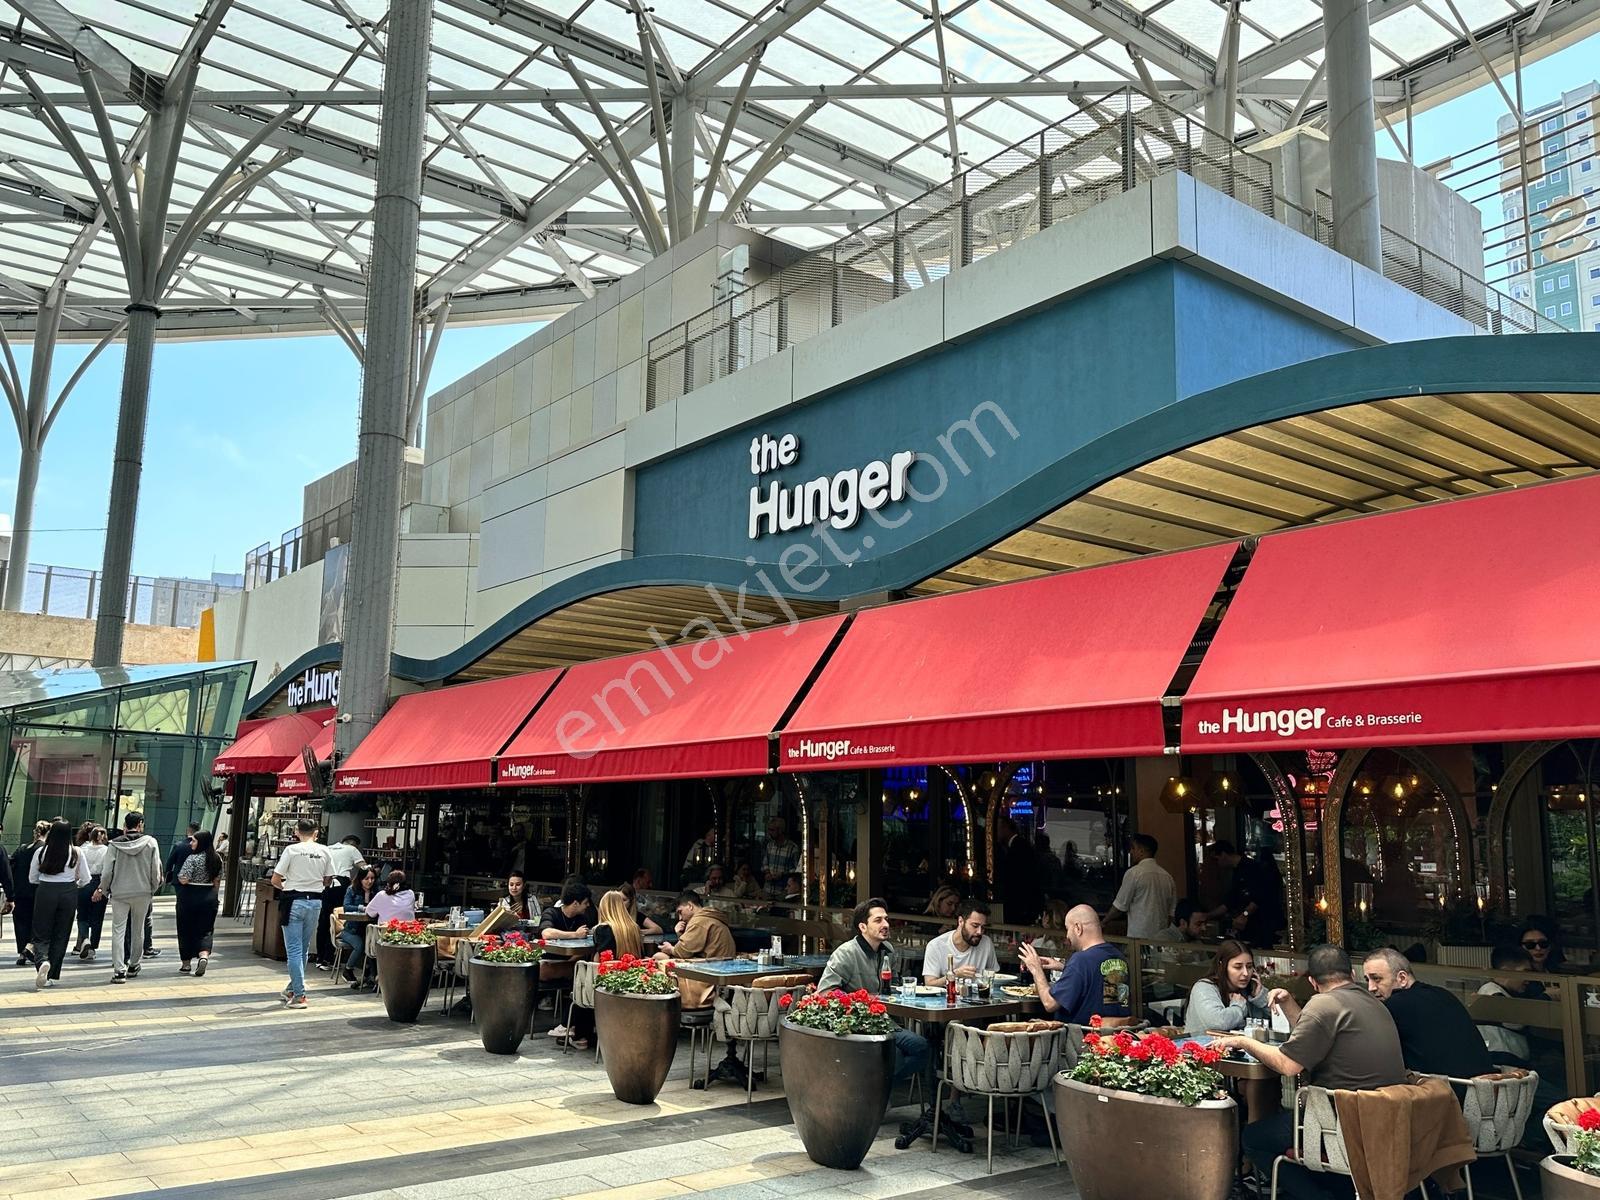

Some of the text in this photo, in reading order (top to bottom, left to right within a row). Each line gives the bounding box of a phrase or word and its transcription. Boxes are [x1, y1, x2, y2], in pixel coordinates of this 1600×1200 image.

[750, 433, 798, 475] the
[749, 451, 914, 539] Hunger
[288, 682, 303, 706] the
[1198, 707, 1422, 737] the Hunger Cafe & Brasserie
[788, 747, 799, 758] the
[800, 739, 850, 760] Hunger
[850, 746, 862, 755] Cafe
[869, 743, 896, 754] Brasserie
[508, 763, 534, 779] Hunger
